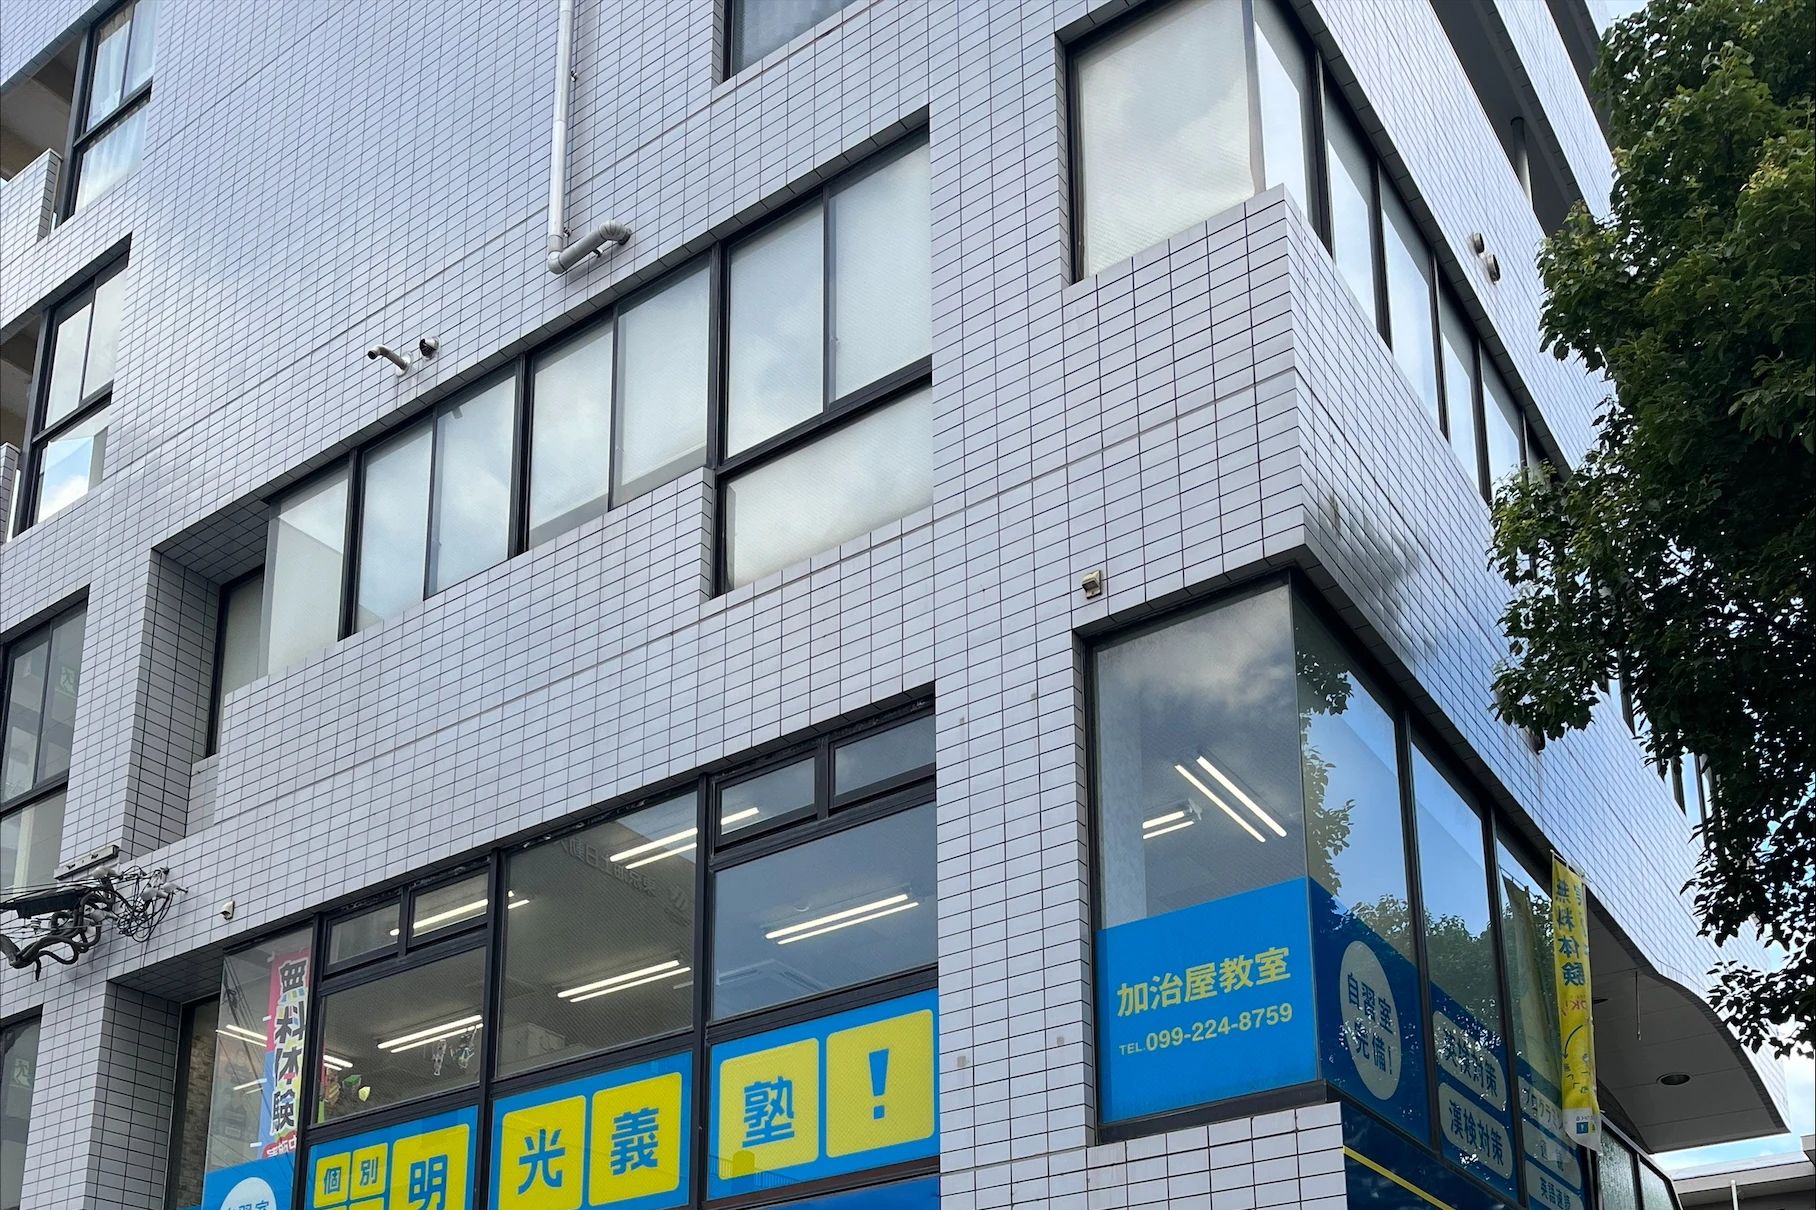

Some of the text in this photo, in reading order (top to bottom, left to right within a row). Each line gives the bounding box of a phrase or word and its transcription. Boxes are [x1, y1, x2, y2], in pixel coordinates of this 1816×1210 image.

[1117, 947, 1291, 1017] 加治屋教室
[1347, 972, 1393, 1036] 自習室
[272, 957, 307, 1135] 無料体験
[1146, 1002, 1293, 1052] 099-224-8759
[1448, 1099, 1504, 1167] 漢検対策
[323, 1156, 379, 1196] 個別
